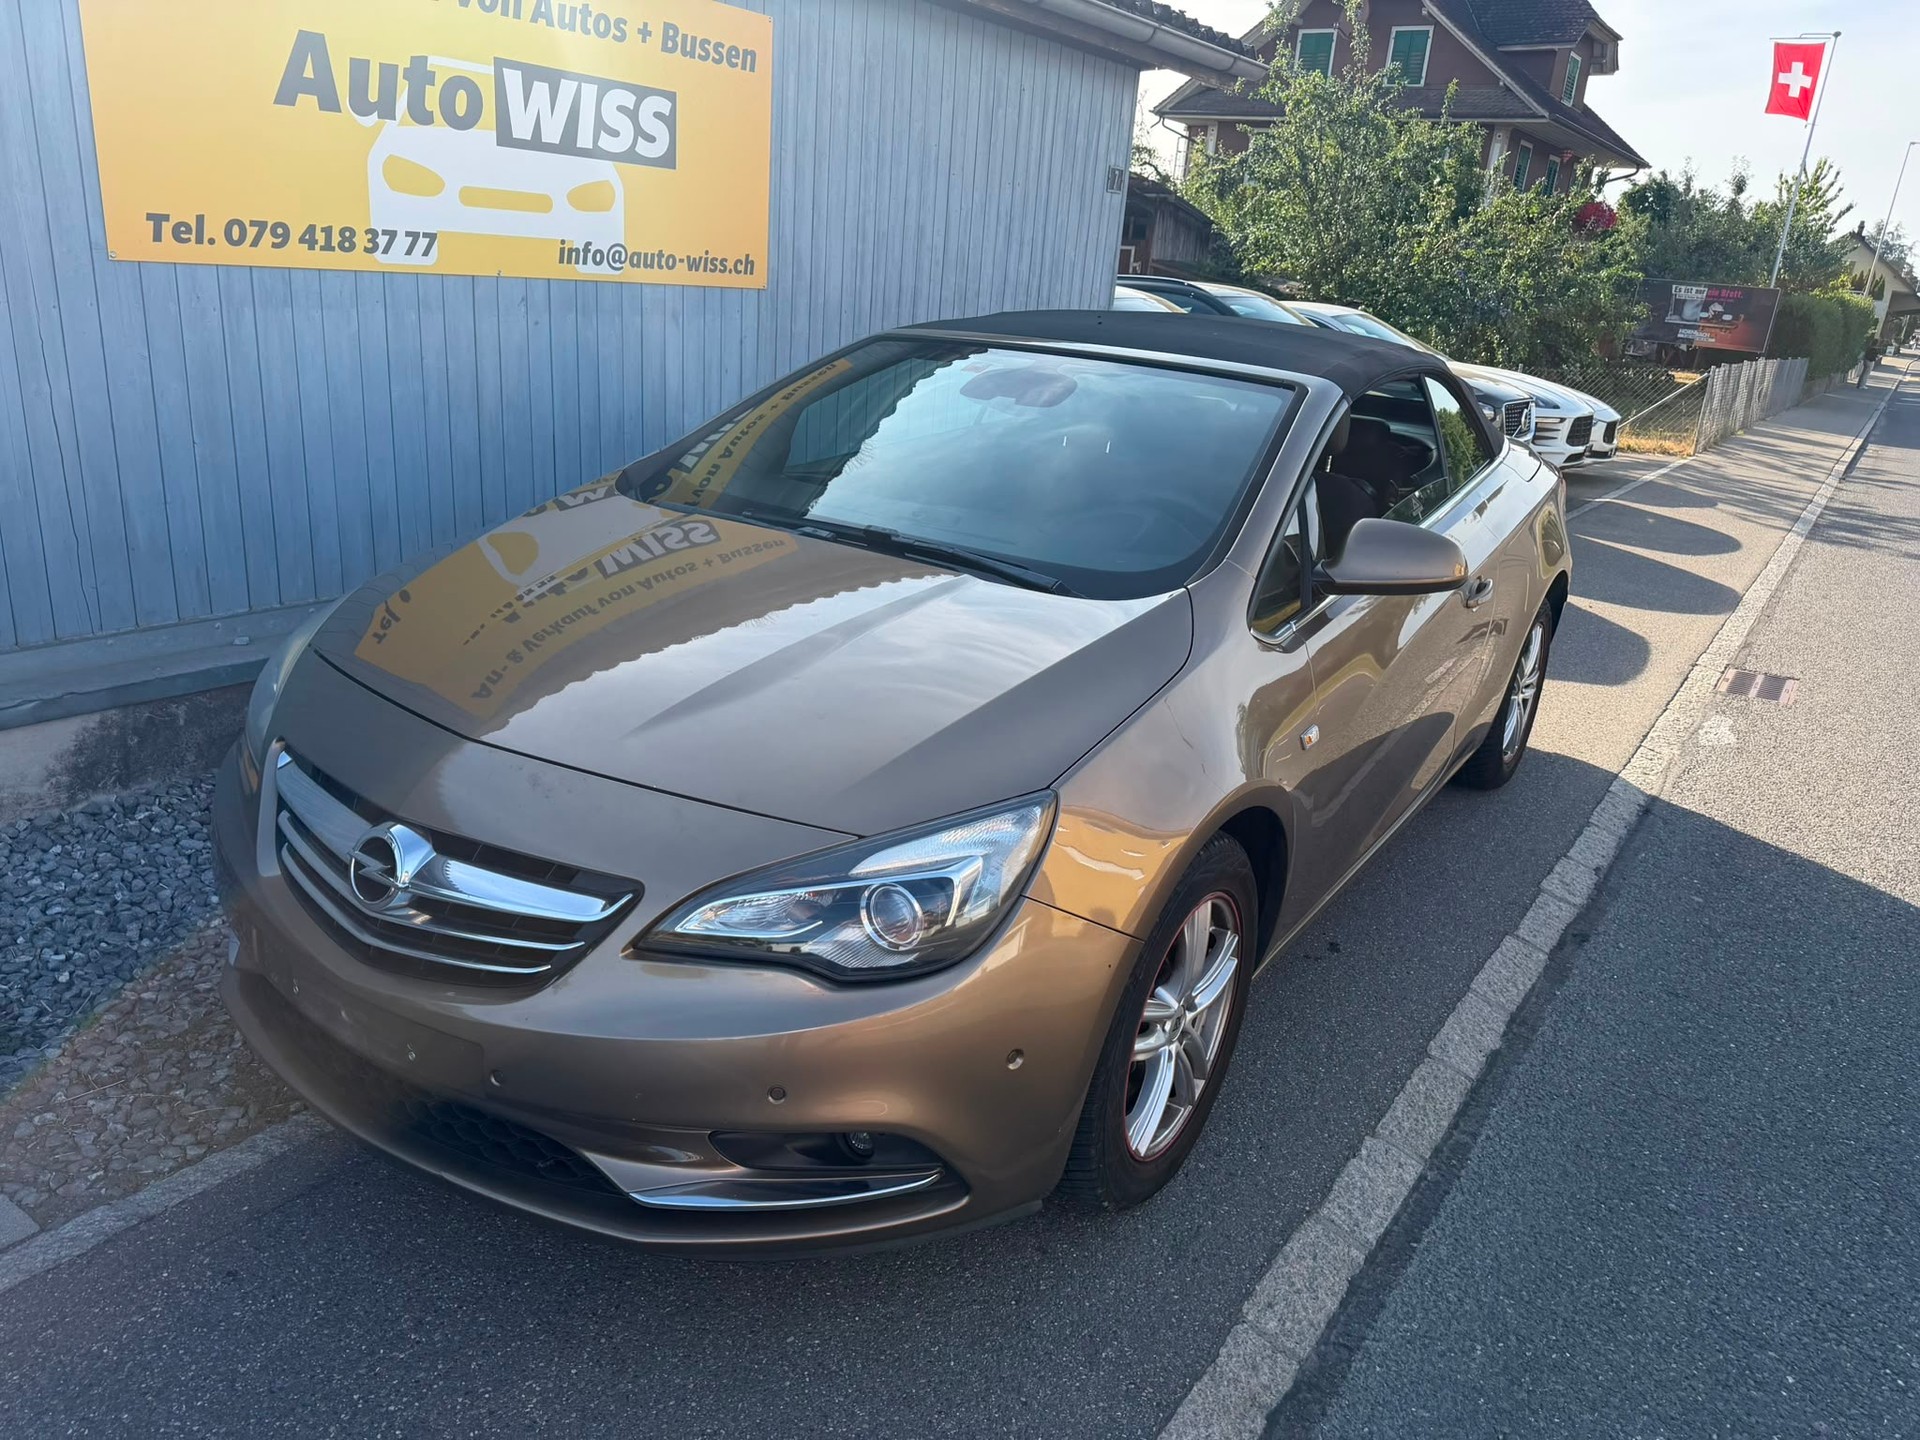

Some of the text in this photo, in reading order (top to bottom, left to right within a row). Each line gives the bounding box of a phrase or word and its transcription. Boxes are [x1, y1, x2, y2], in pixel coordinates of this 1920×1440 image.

[530, 0, 628, 43] Autos
[660, 21, 758, 73] Bussen
[273, 29, 673, 159] Auto WISS
[146, 212, 438, 257] Tel. 079 418 37 77
[558, 239, 755, 276] info@auto-wiss.ch
